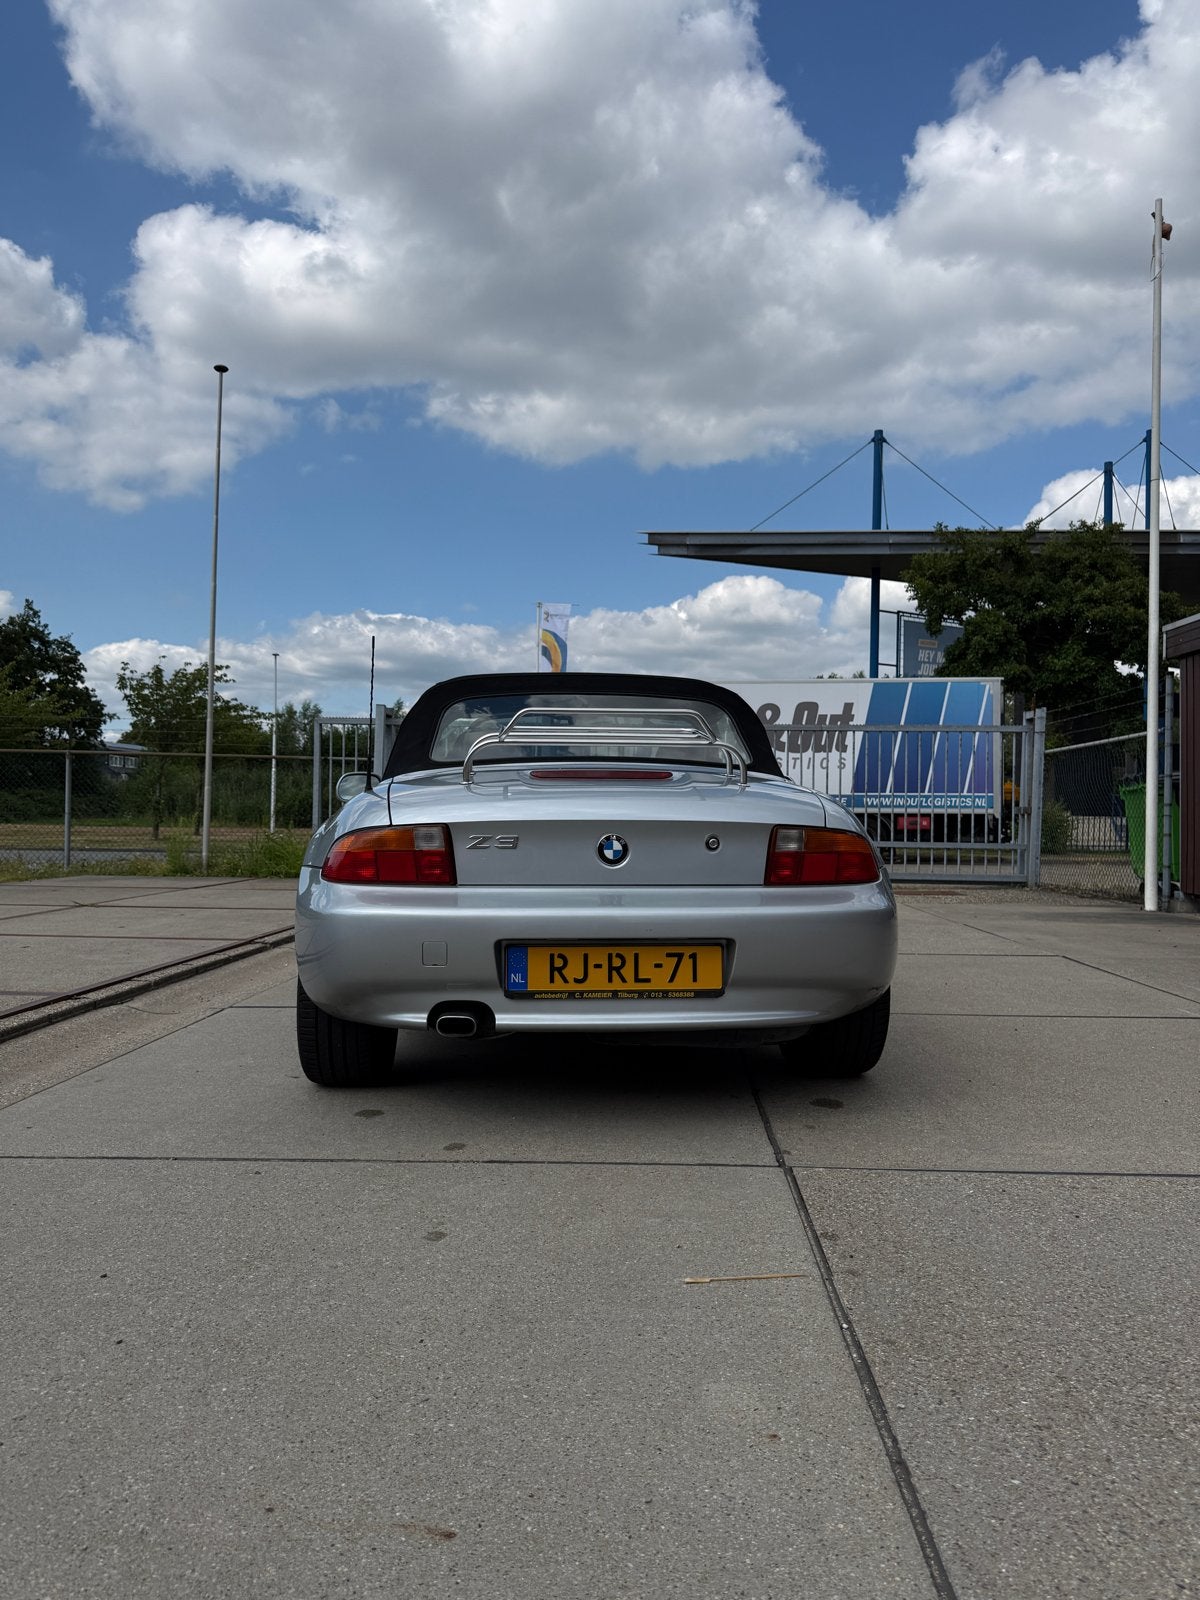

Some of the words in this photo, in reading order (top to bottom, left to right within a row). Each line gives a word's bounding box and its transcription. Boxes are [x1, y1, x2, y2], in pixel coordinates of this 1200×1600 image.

[918, 649, 935, 663] HEY
[788, 701, 855, 753] Out
[465, 834, 519, 849] Z3
[549, 952, 698, 984] RJ-RL-71
[510, 973, 525, 983] NL
